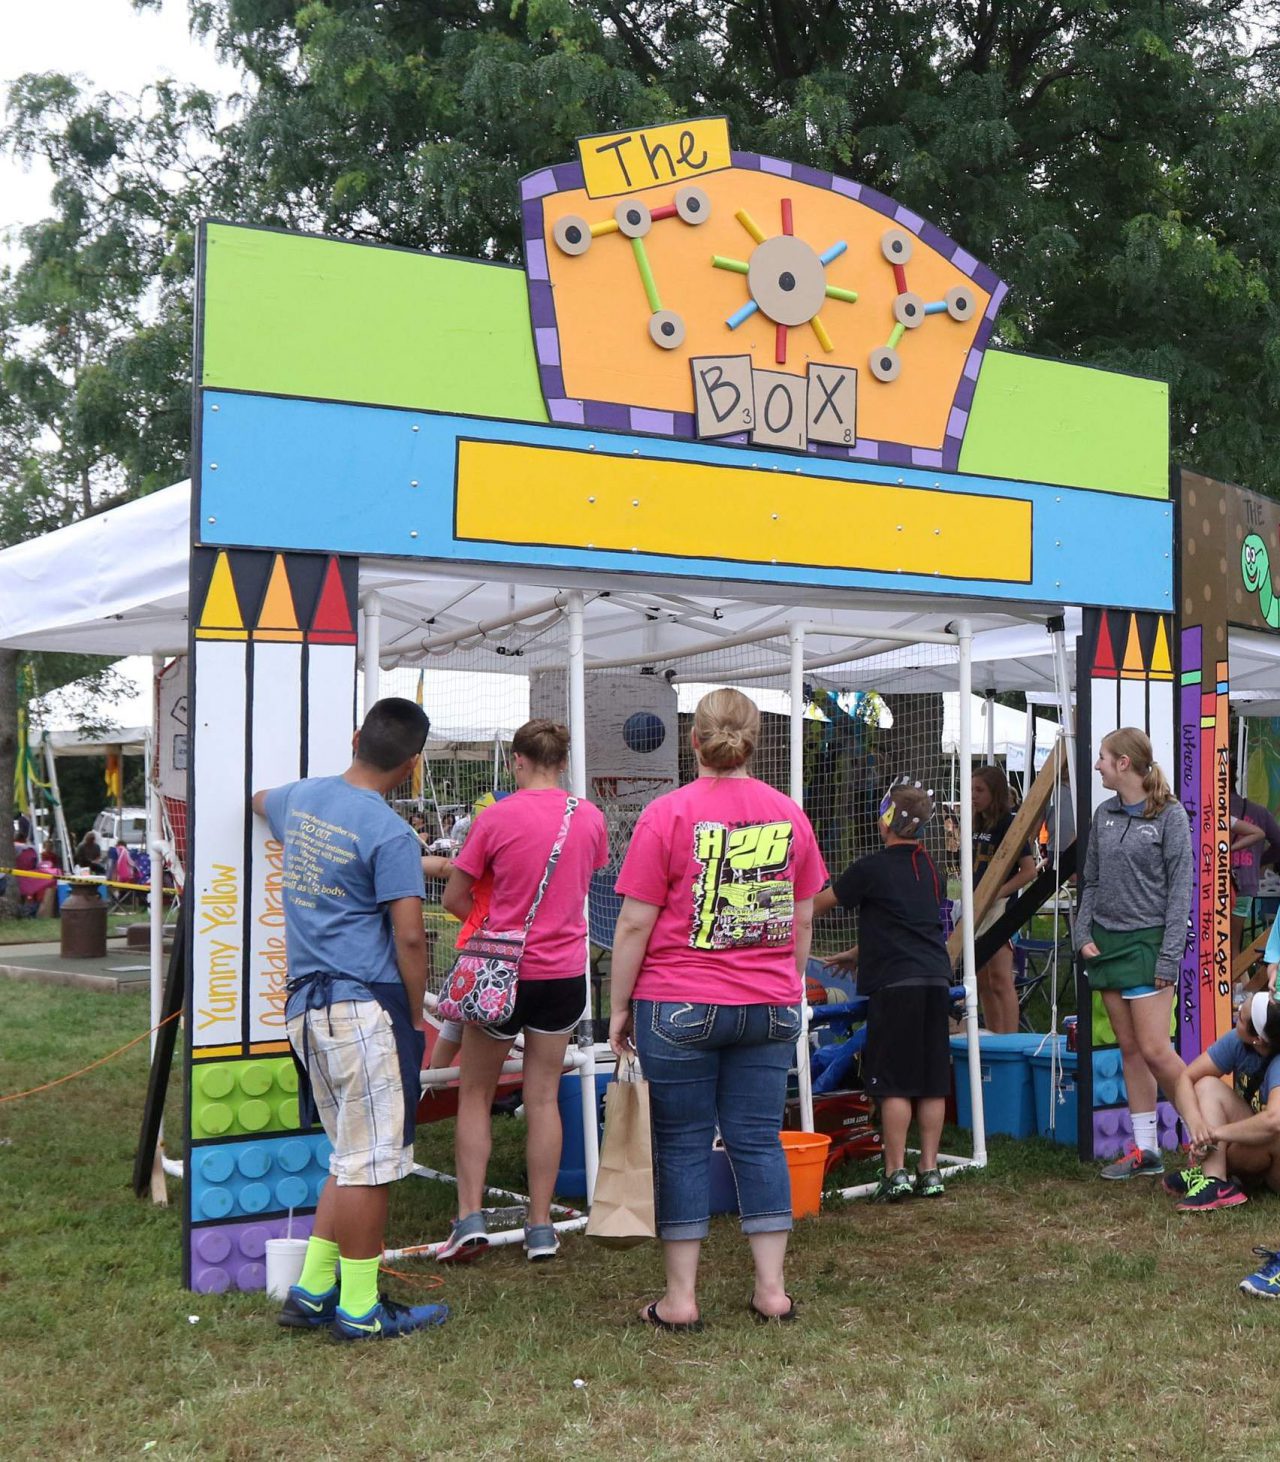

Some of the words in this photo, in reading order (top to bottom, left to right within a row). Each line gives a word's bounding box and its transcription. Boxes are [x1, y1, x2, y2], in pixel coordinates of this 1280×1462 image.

[595, 130, 709, 187] The
[700, 366, 846, 434] BOX
[1242, 499, 1265, 526] THE
[1181, 724, 1197, 788] Where
[1202, 793, 1215, 835] The
[1216, 744, 1230, 832] Ramona
[726, 821, 793, 870] 26
[200, 864, 238, 934] Yellow
[1214, 931, 1229, 975] Age
[197, 940, 240, 1030] Yummy
[1218, 980, 1230, 997] 8
